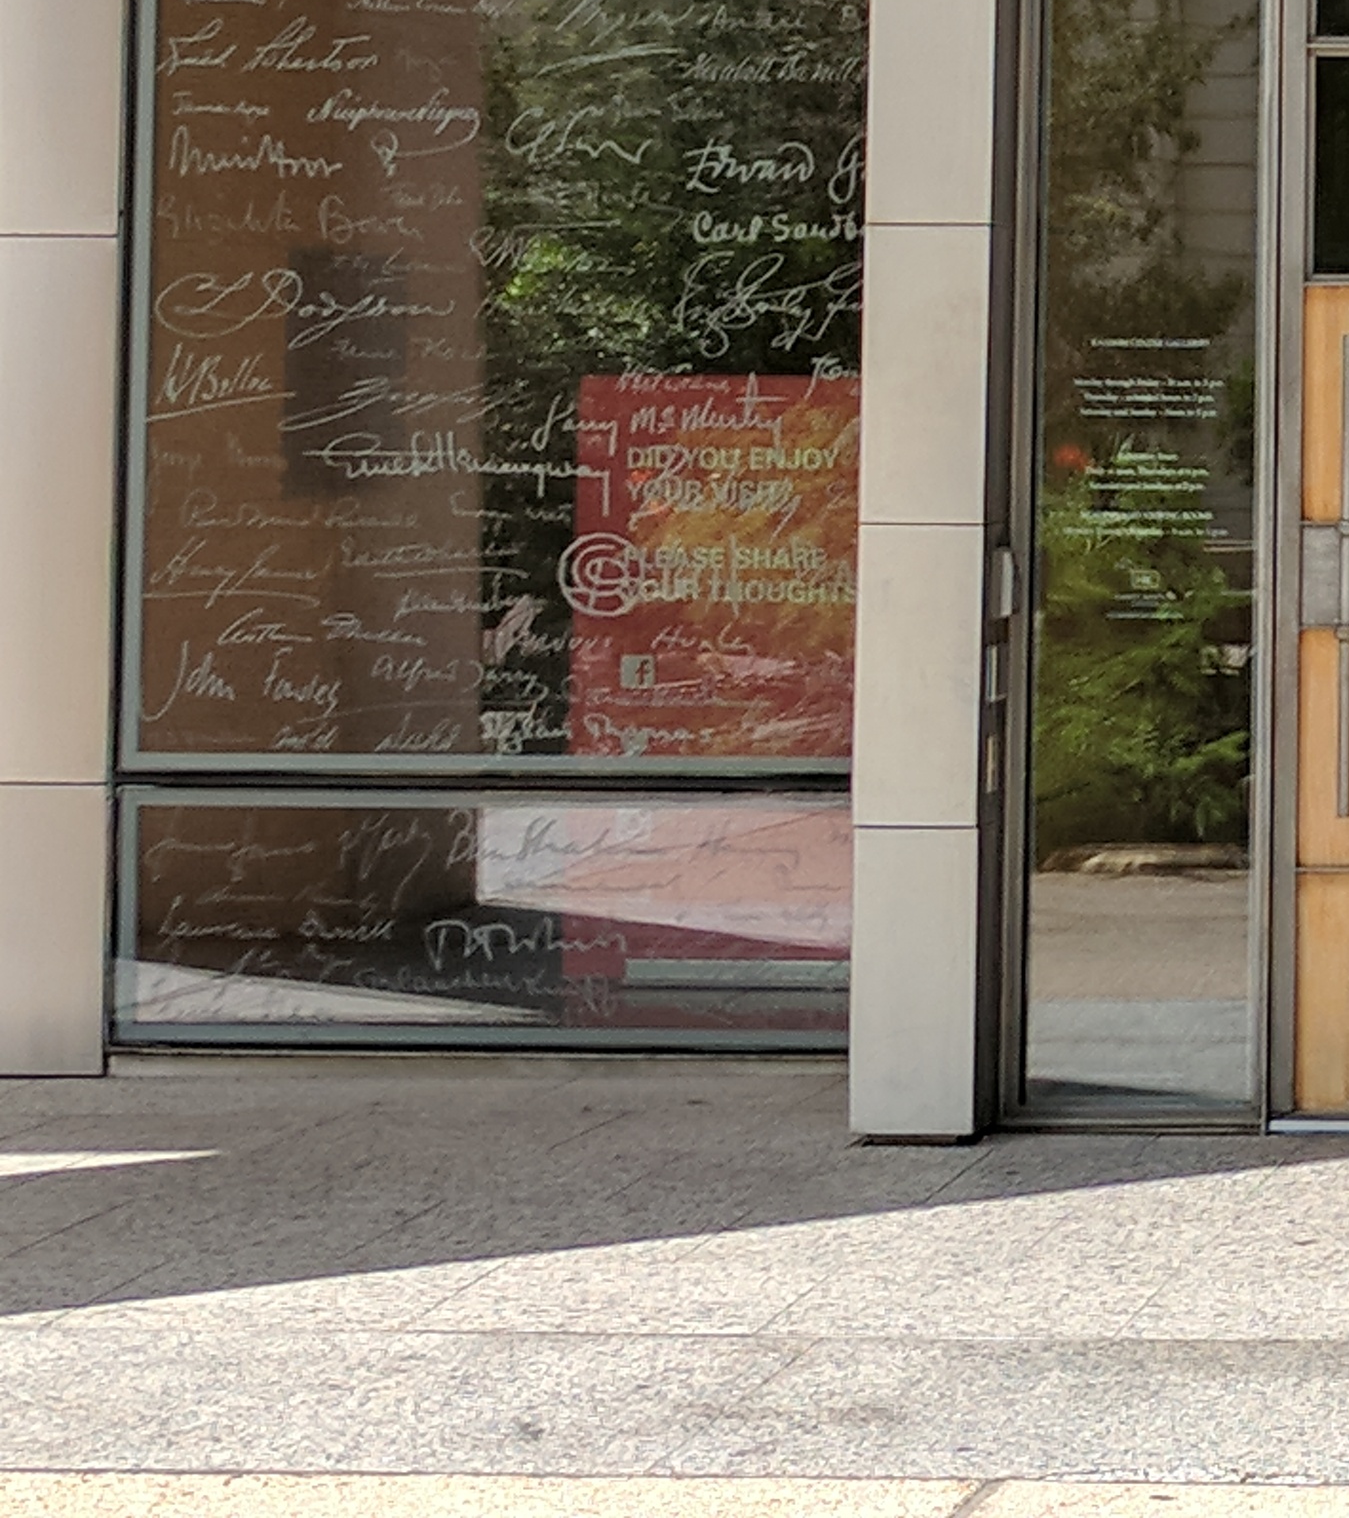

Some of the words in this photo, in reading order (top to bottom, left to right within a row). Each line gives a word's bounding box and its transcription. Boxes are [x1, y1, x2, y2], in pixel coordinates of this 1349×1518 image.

[627, 447, 671, 470] DID
[681, 448, 741, 470] YOU
[750, 447, 841, 471] ENJOY
[739, 547, 826, 571] SHARE
